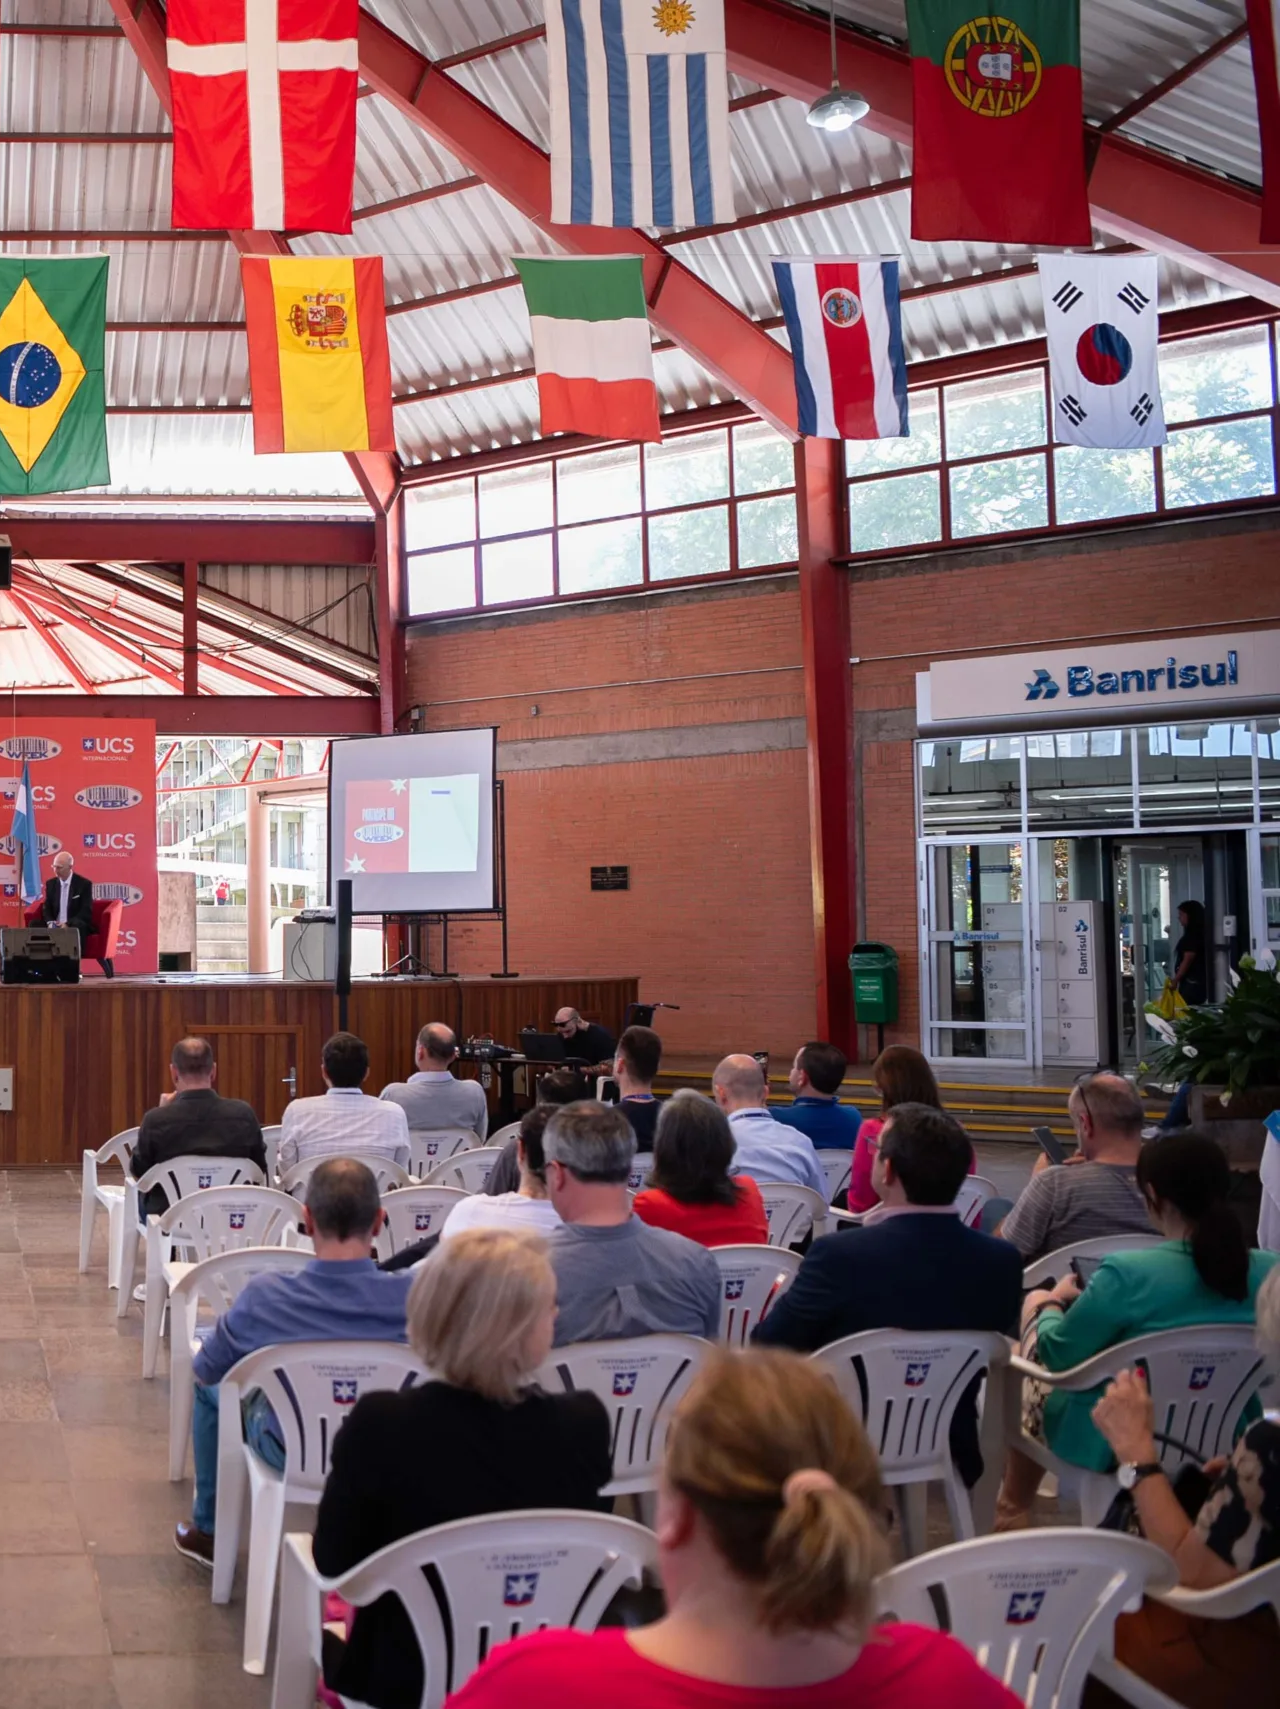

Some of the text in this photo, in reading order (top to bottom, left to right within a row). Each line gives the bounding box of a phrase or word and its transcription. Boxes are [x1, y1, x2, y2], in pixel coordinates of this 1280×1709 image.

[1067, 650, 1238, 697] Banrisul
[95, 737, 135, 753] UCS
[6, 750, 49, 760] WEEK
[86, 787, 129, 800] INTERNATIONAL
[87, 799, 129, 808] WEEK
[96, 833, 136, 850] UCS
[962, 931, 1000, 941] Banrisul
[1078, 934, 1088, 975] Banrisul
